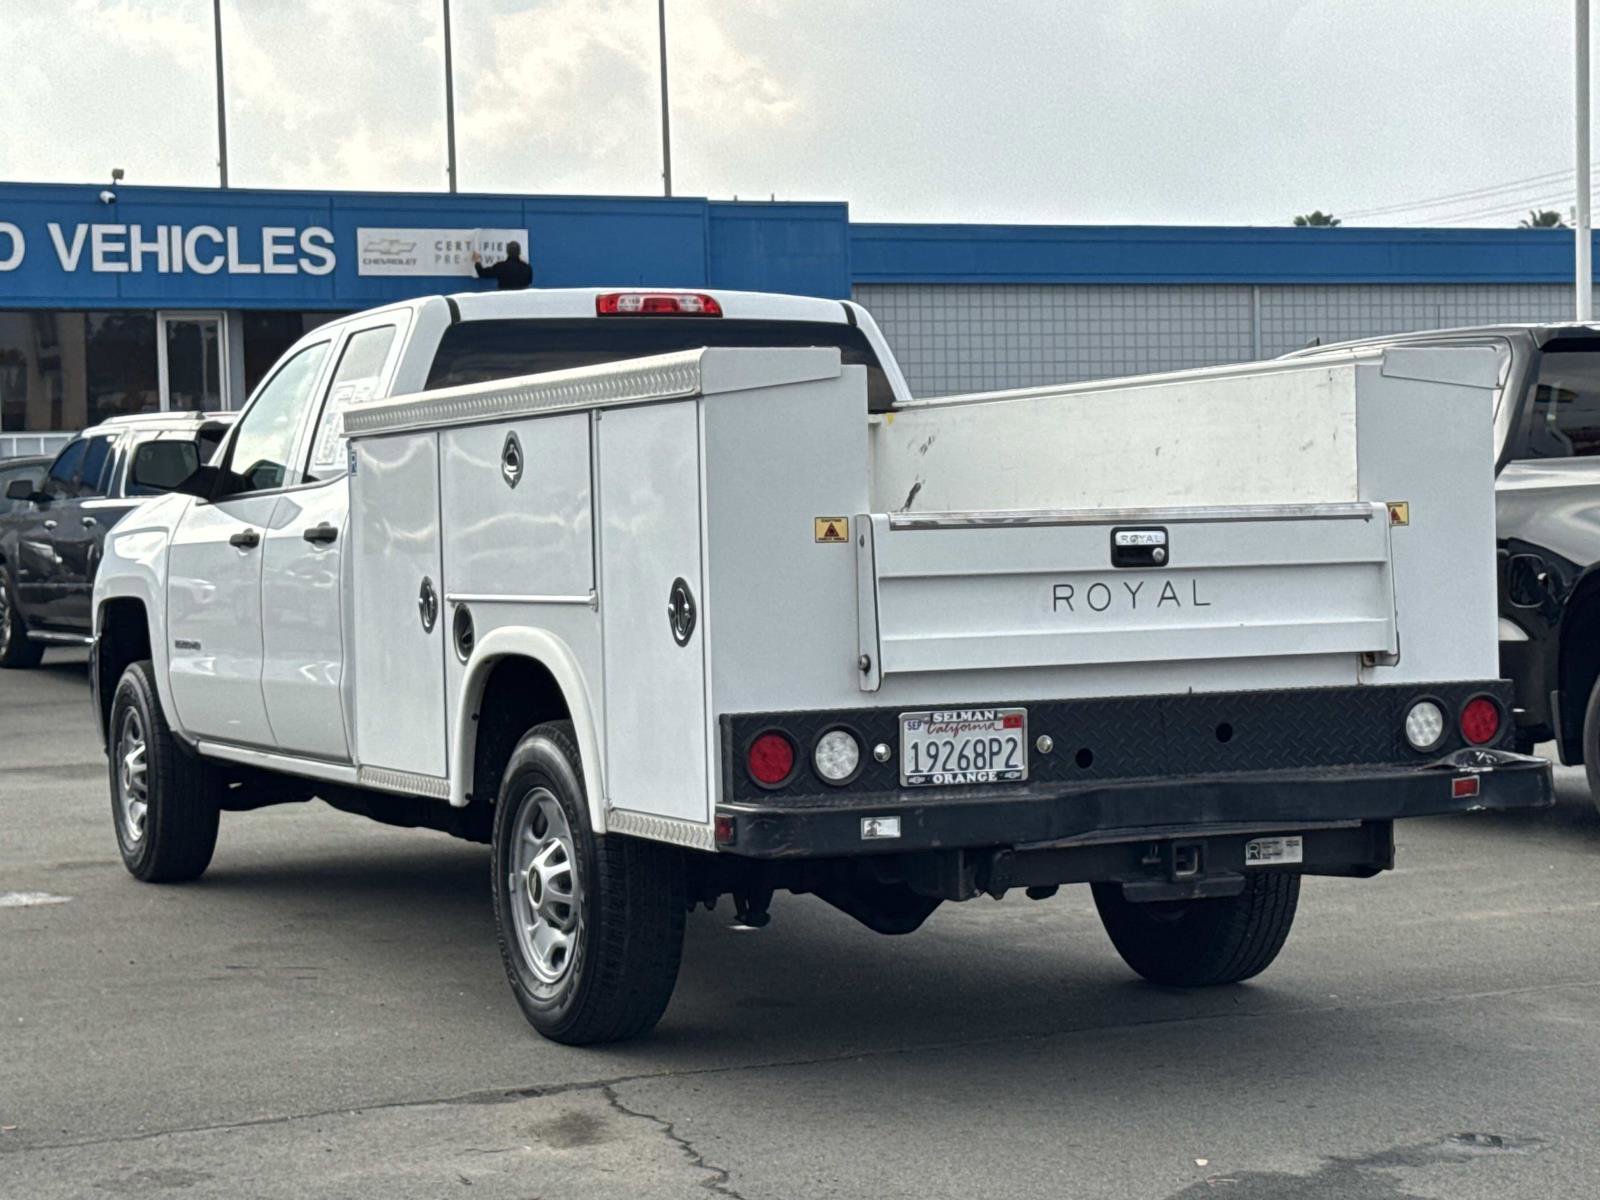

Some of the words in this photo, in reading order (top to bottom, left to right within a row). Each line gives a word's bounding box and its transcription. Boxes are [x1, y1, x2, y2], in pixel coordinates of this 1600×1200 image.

[47, 222, 337, 276] VEHICLES
[362, 257, 417, 265] CHEVROLET
[1120, 534, 1162, 544] ROYAL
[1052, 579, 1212, 613] ROYAL
[932, 710, 996, 723] SELMAN
[906, 720, 922, 731] SEP
[927, 721, 1003, 738] California
[910, 736, 1019, 774] 19268P2
[932, 771, 998, 785] ORANGE
